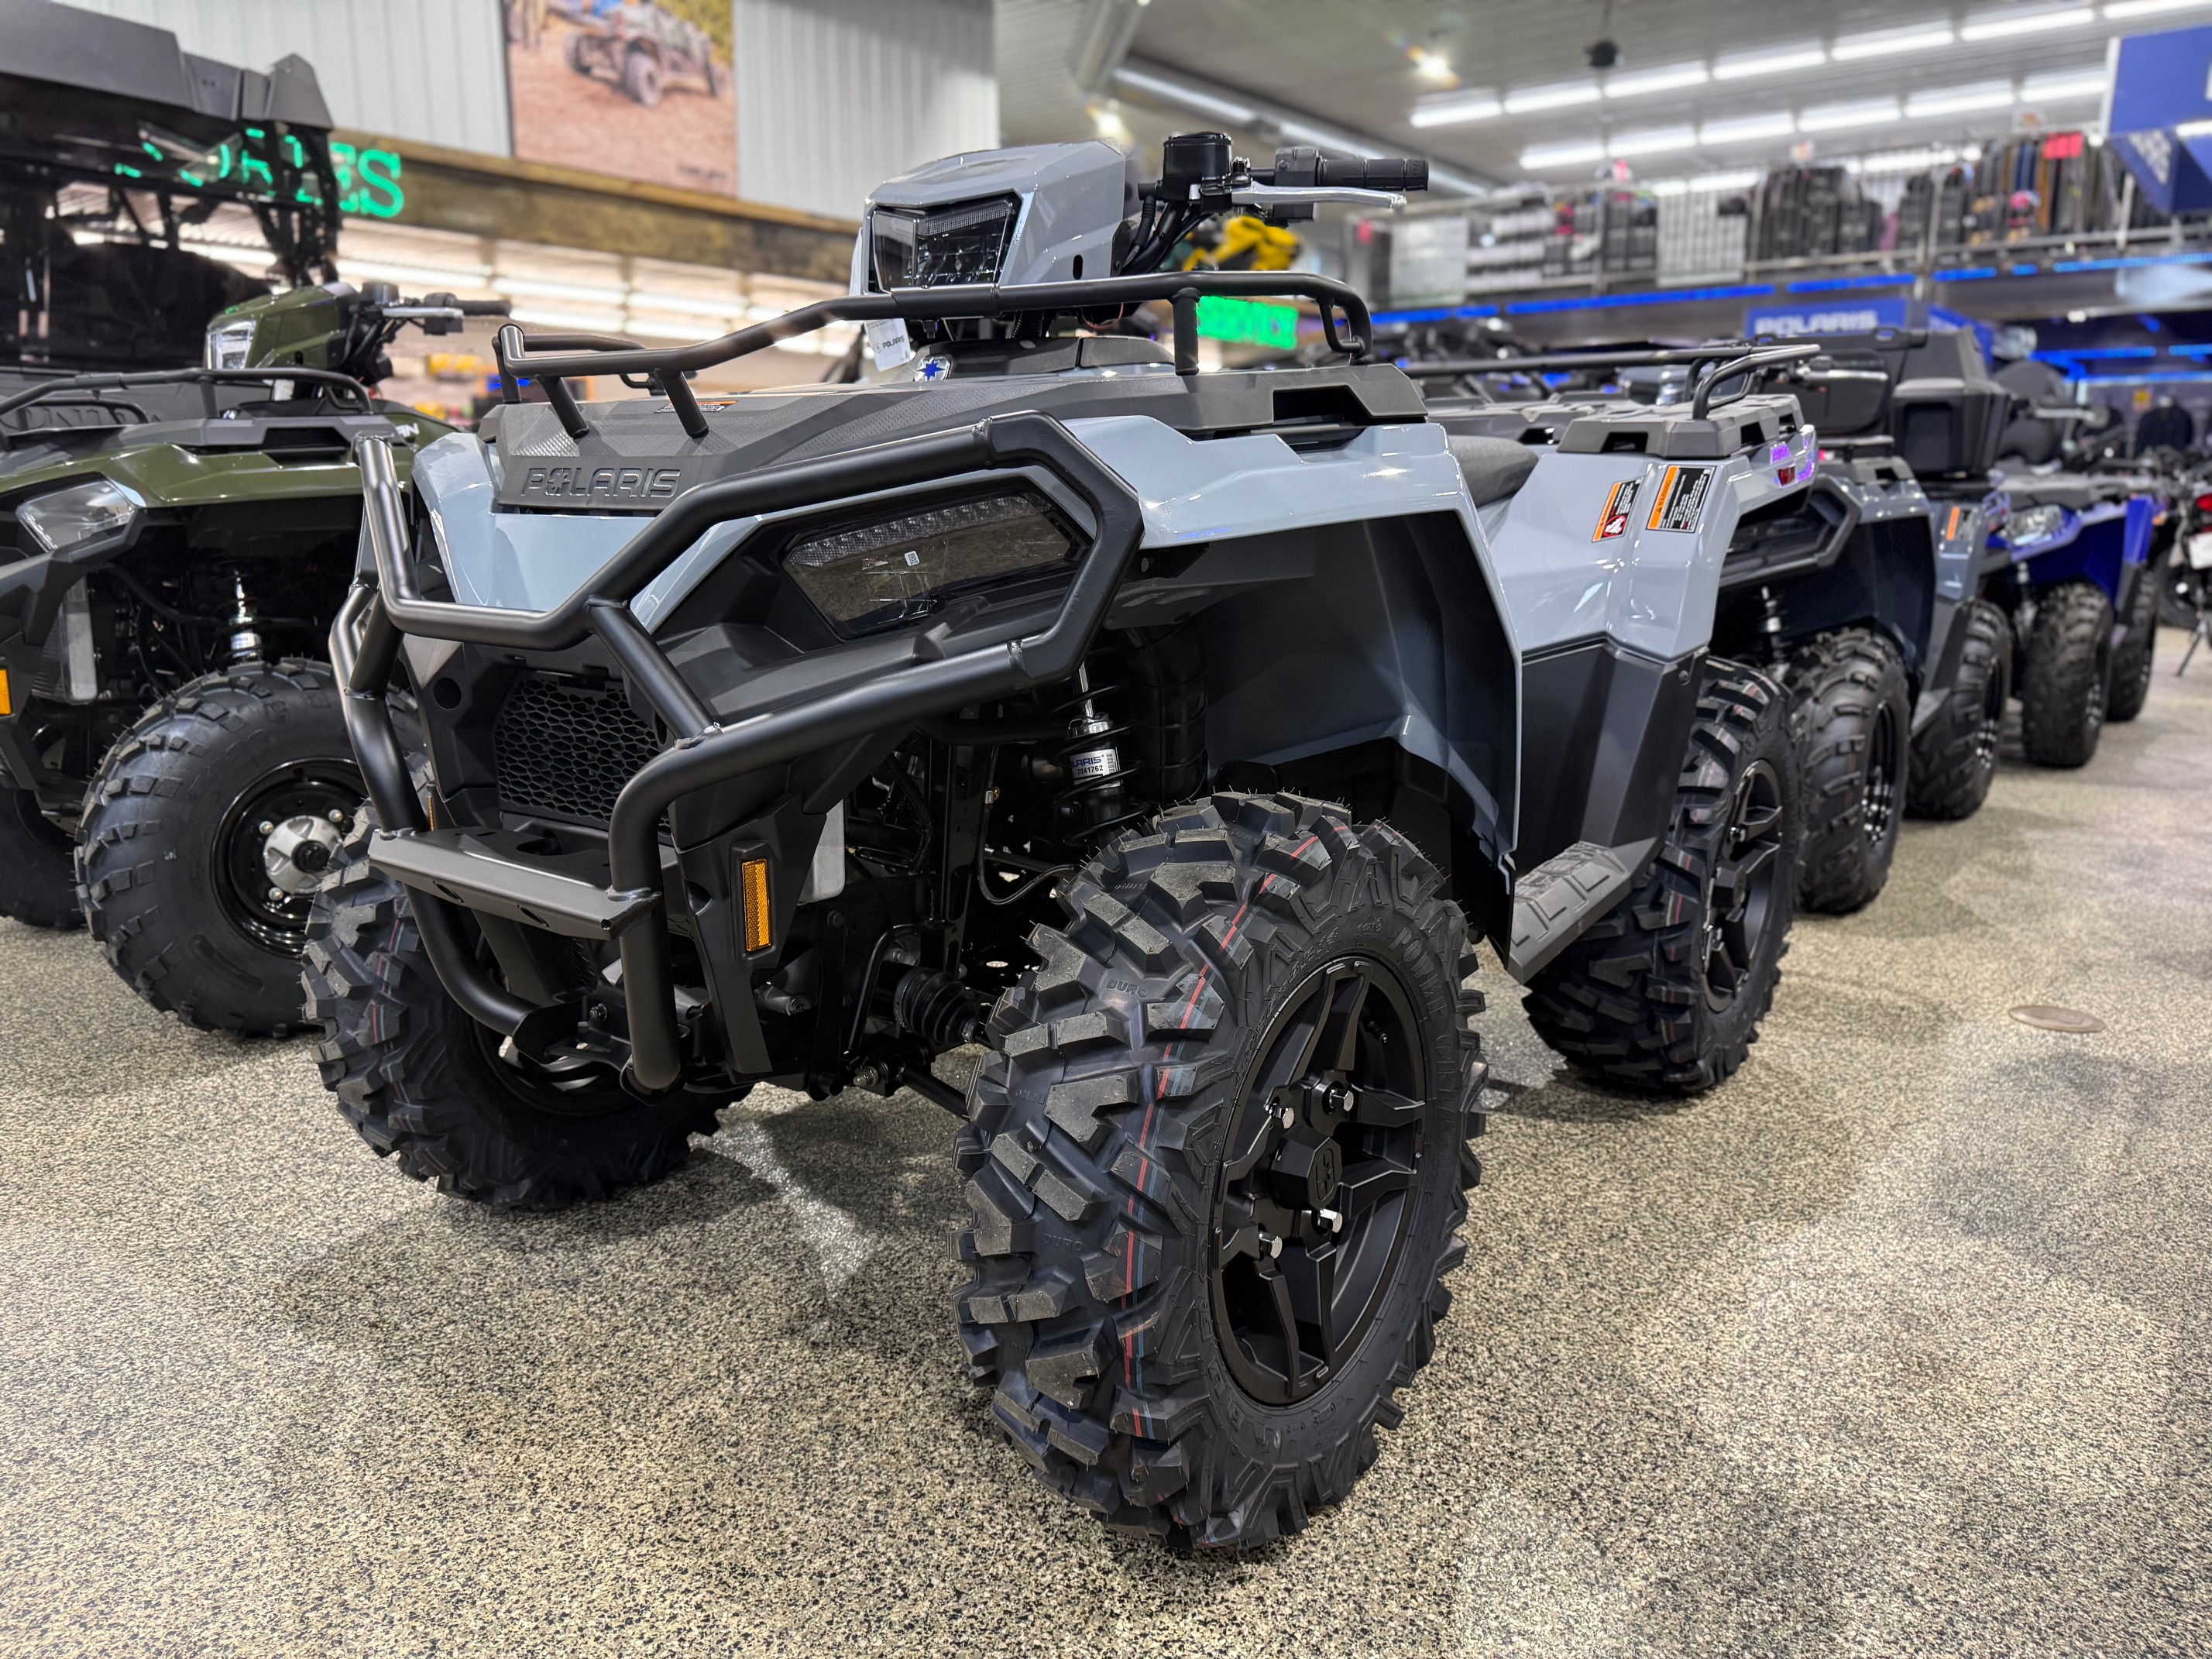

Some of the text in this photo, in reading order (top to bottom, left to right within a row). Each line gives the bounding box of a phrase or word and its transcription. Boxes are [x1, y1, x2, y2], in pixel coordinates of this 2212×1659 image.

[521, 468, 681, 498] POLARIS
[1077, 765, 1104, 776] 7041762
[1106, 978, 1148, 998] DURO
